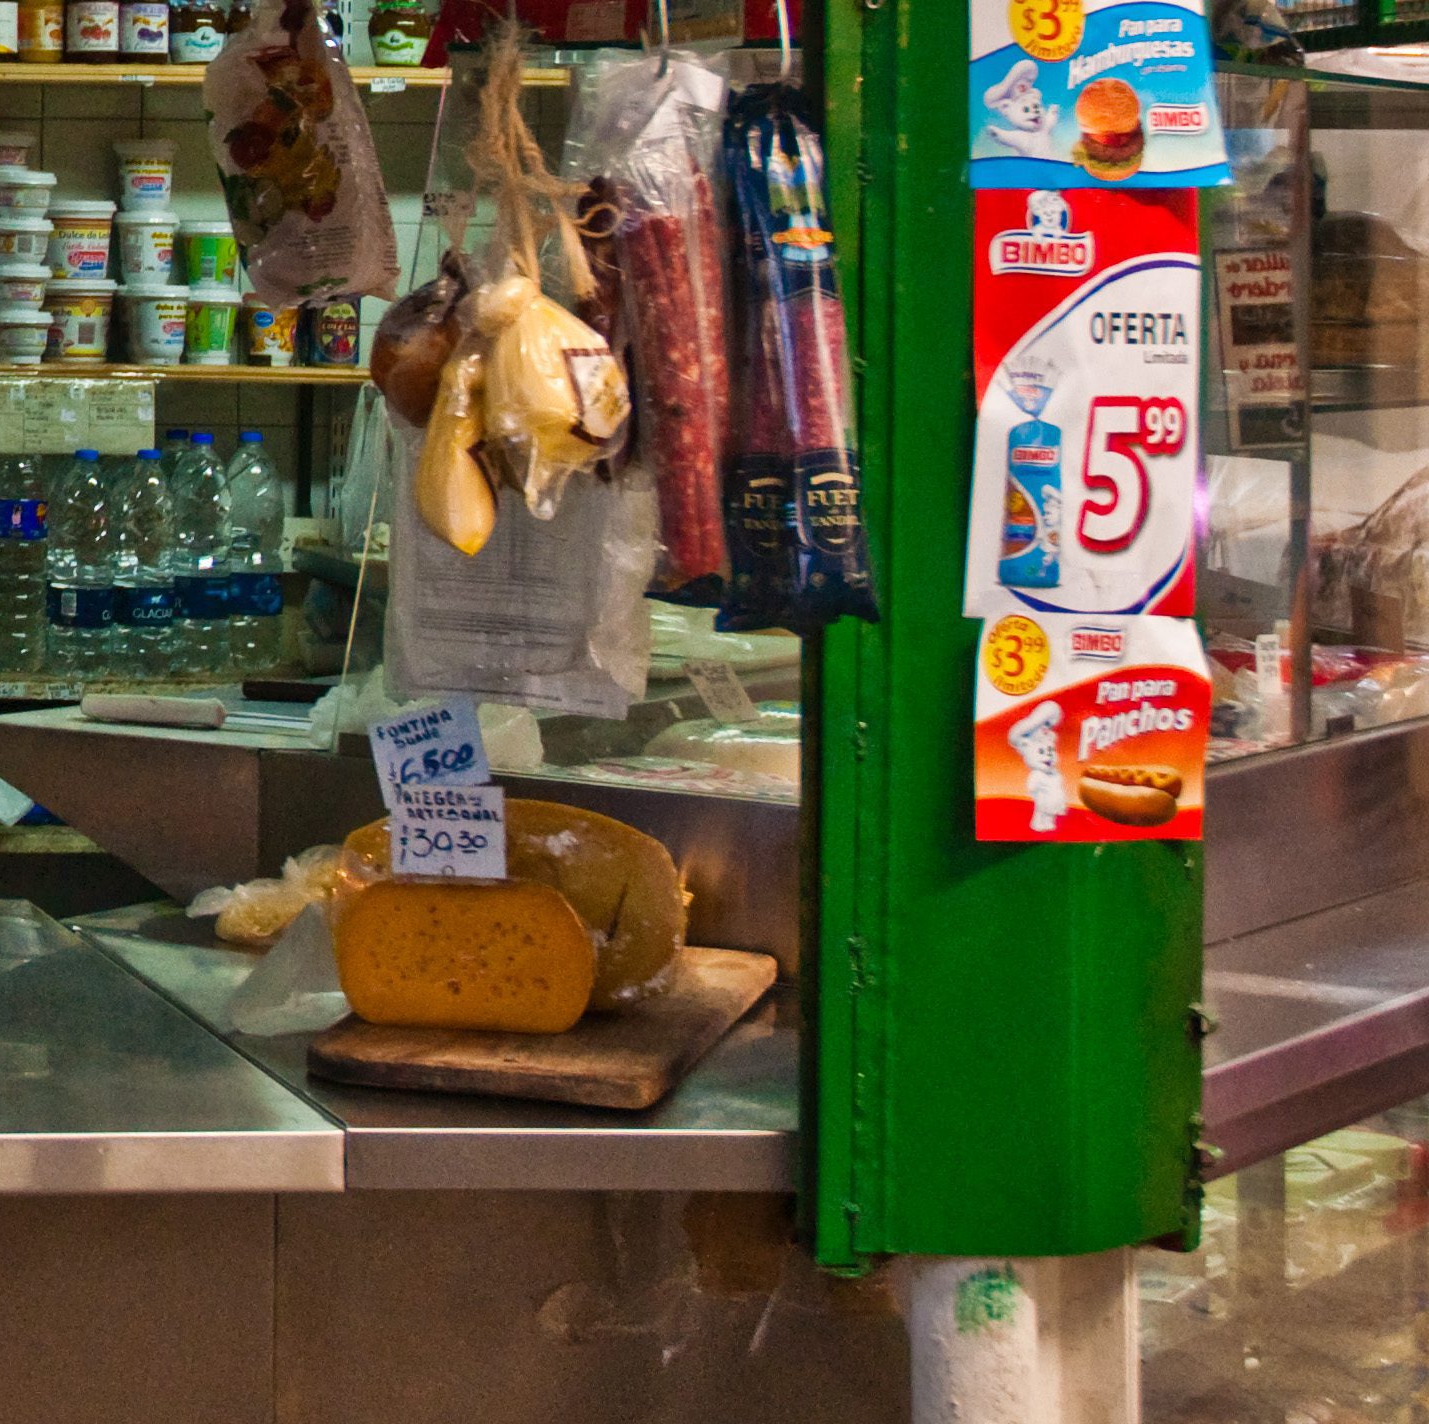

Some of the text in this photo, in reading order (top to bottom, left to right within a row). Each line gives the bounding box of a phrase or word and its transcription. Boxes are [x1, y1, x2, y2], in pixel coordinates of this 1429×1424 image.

[1118, 18, 1183, 38] Pan para
[1067, 40, 1196, 90] Hamburguesas
[1150, 110, 1202, 128] BIMBO
[1000, 240, 1087, 266] BIMBO
[1090, 312, 1189, 345] OFERTA
[1071, 633, 1124, 652] BIMBO
[1096, 679, 1177, 705] Pan para
[1077, 702, 1194, 762] Panchos
